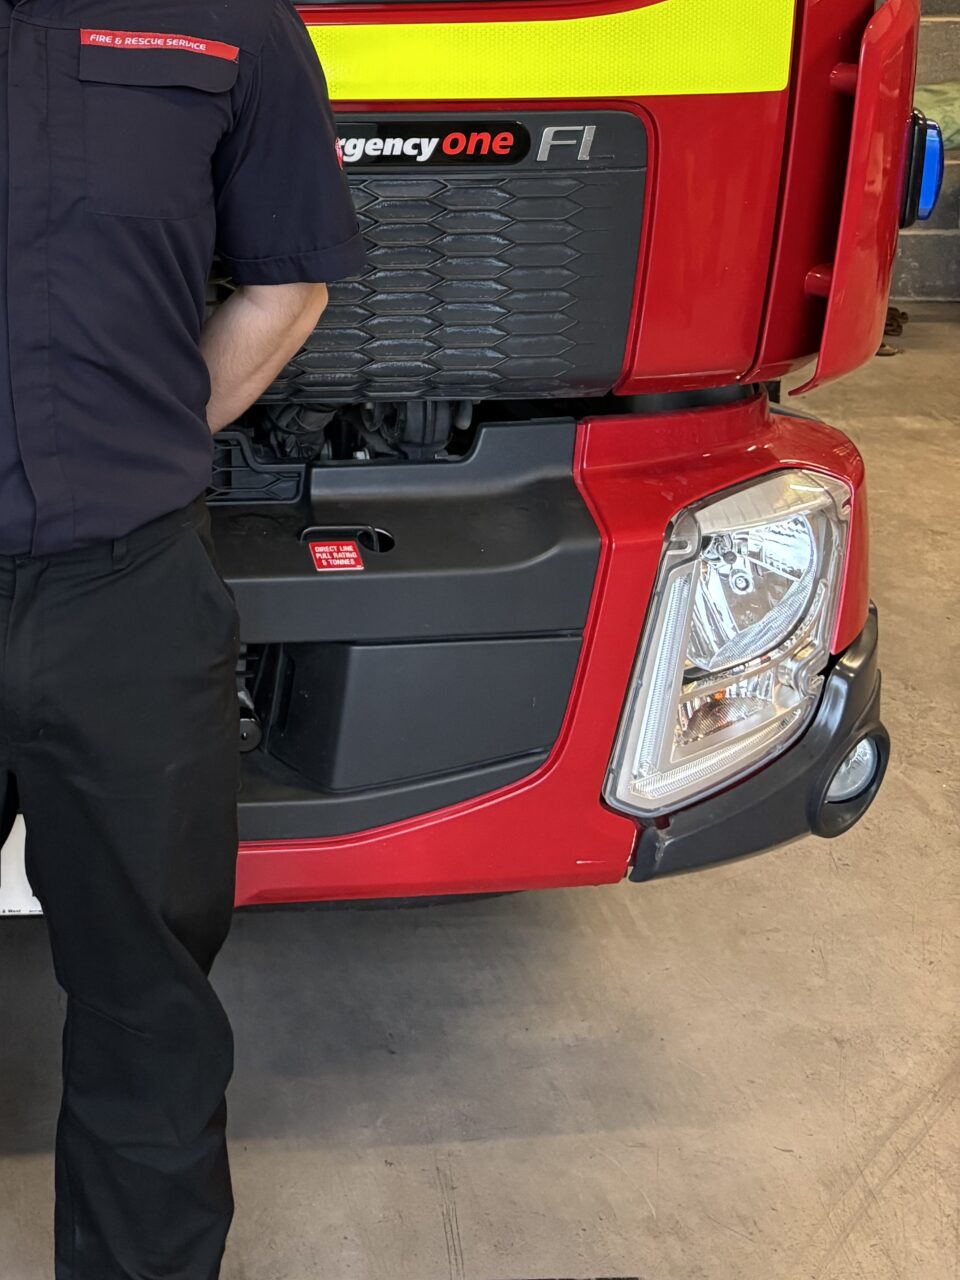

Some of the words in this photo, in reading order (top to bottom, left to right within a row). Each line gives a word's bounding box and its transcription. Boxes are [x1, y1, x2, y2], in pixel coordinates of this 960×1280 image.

[90, 34, 112, 43] FIRE
[115, 37, 121, 45] &
[124, 37, 164, 46] RESCUE
[166, 38, 207, 51] SERVICE
[442, 131, 514, 155] one
